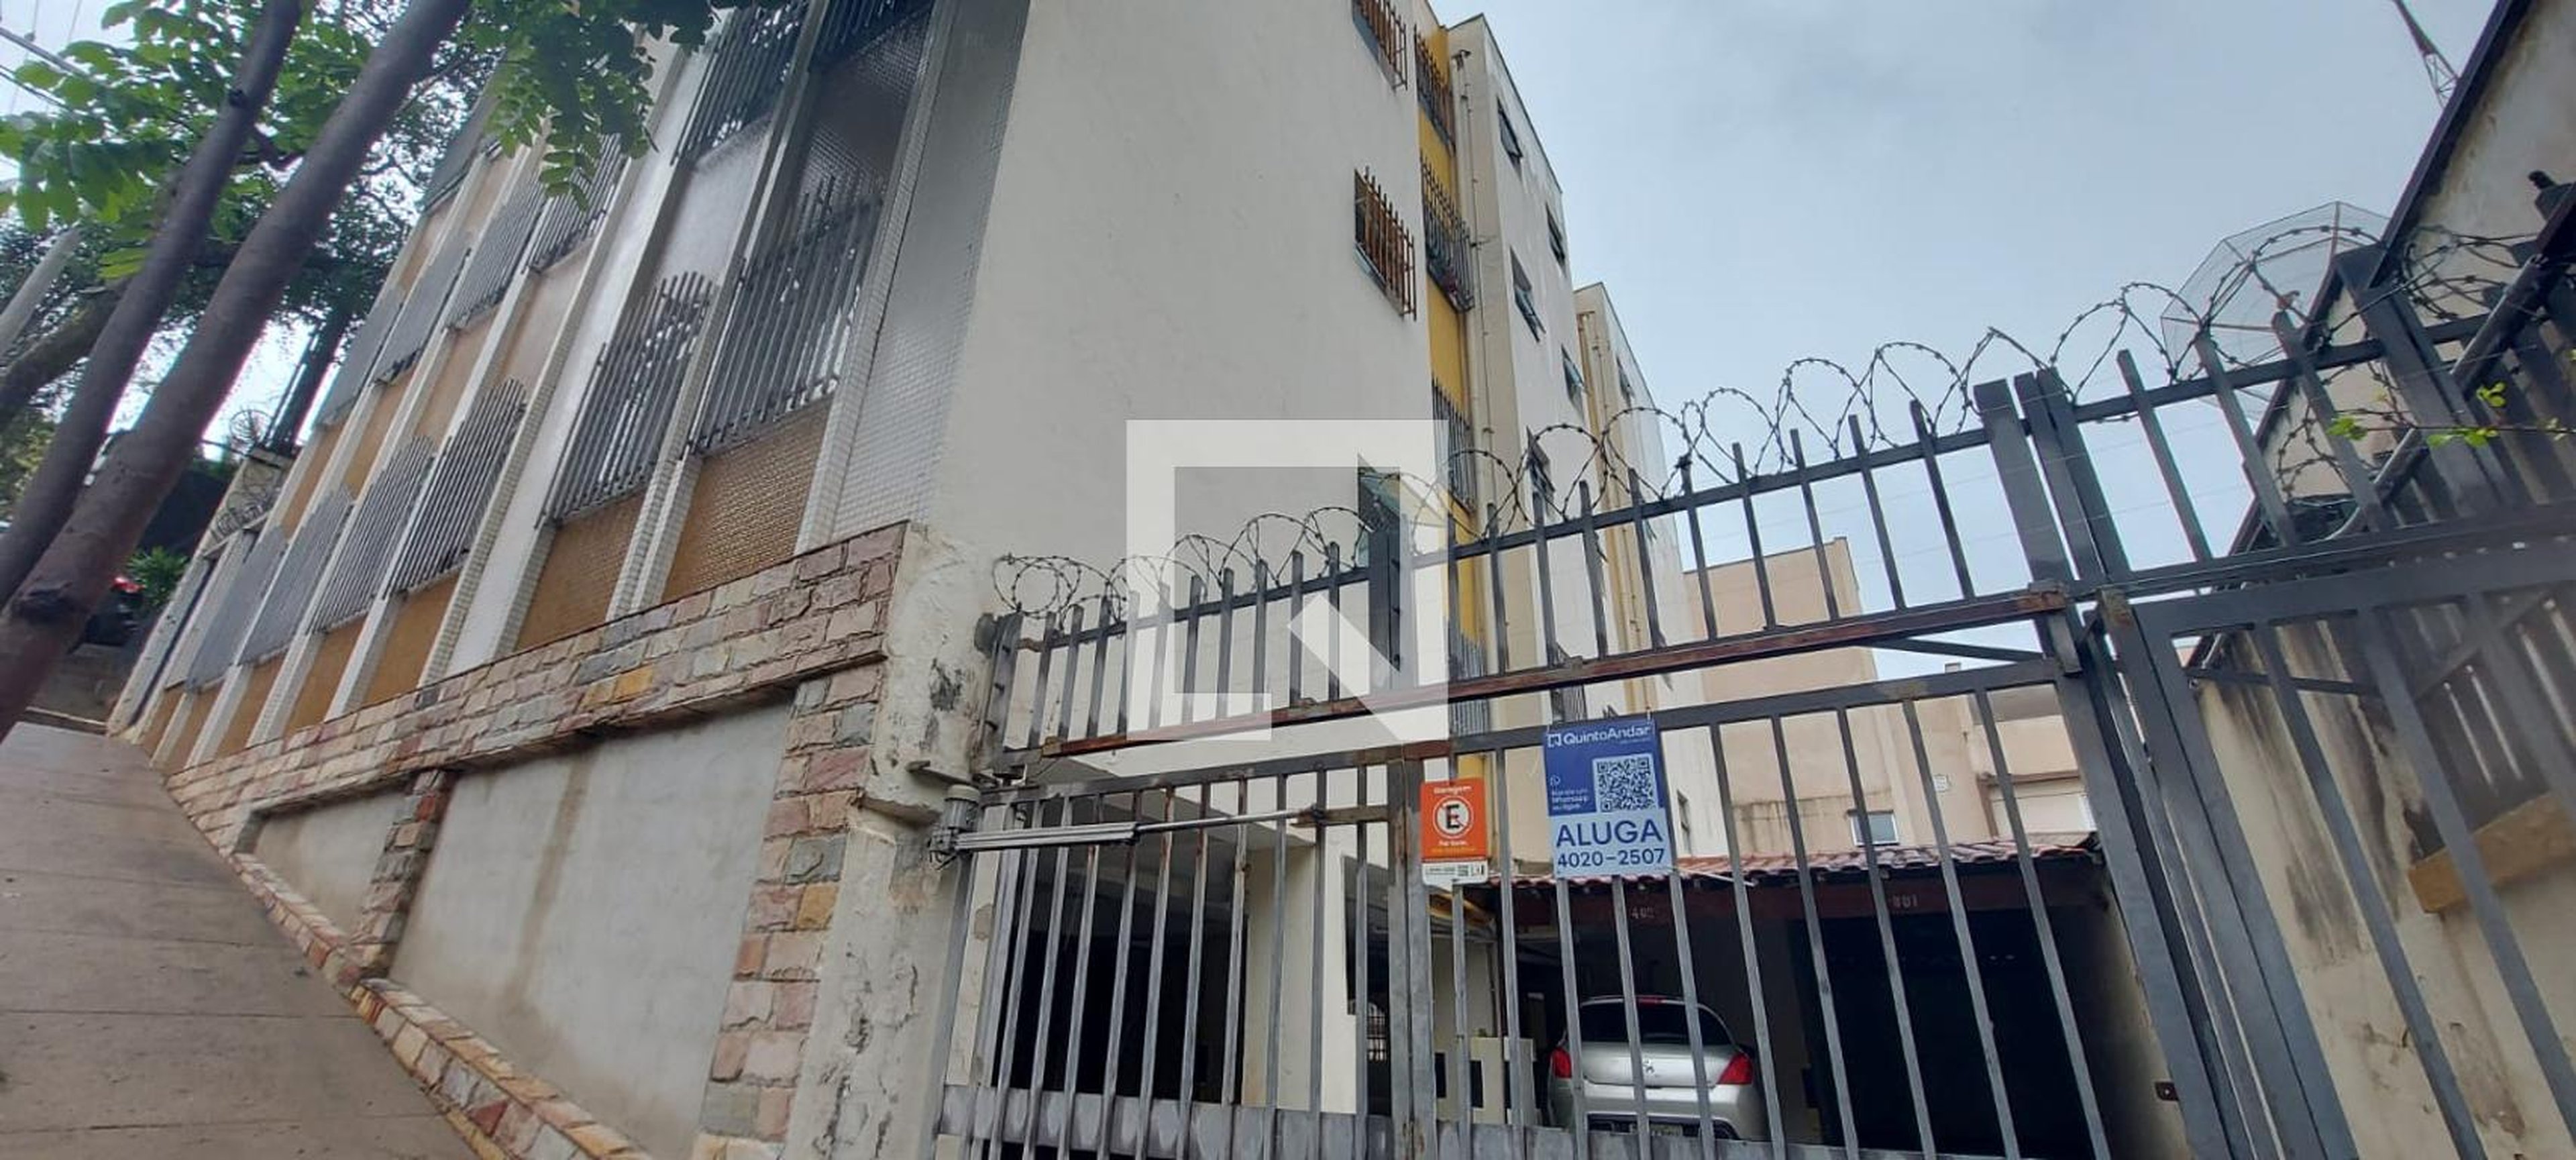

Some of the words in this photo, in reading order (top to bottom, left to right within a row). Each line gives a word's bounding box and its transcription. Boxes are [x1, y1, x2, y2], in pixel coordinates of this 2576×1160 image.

[1563, 725, 1651, 745] QuintoAndar
[1446, 804, 1460, 829] E
[1556, 819, 1664, 847] ALUGA
[1557, 848, 1665, 867] 4020-2507
